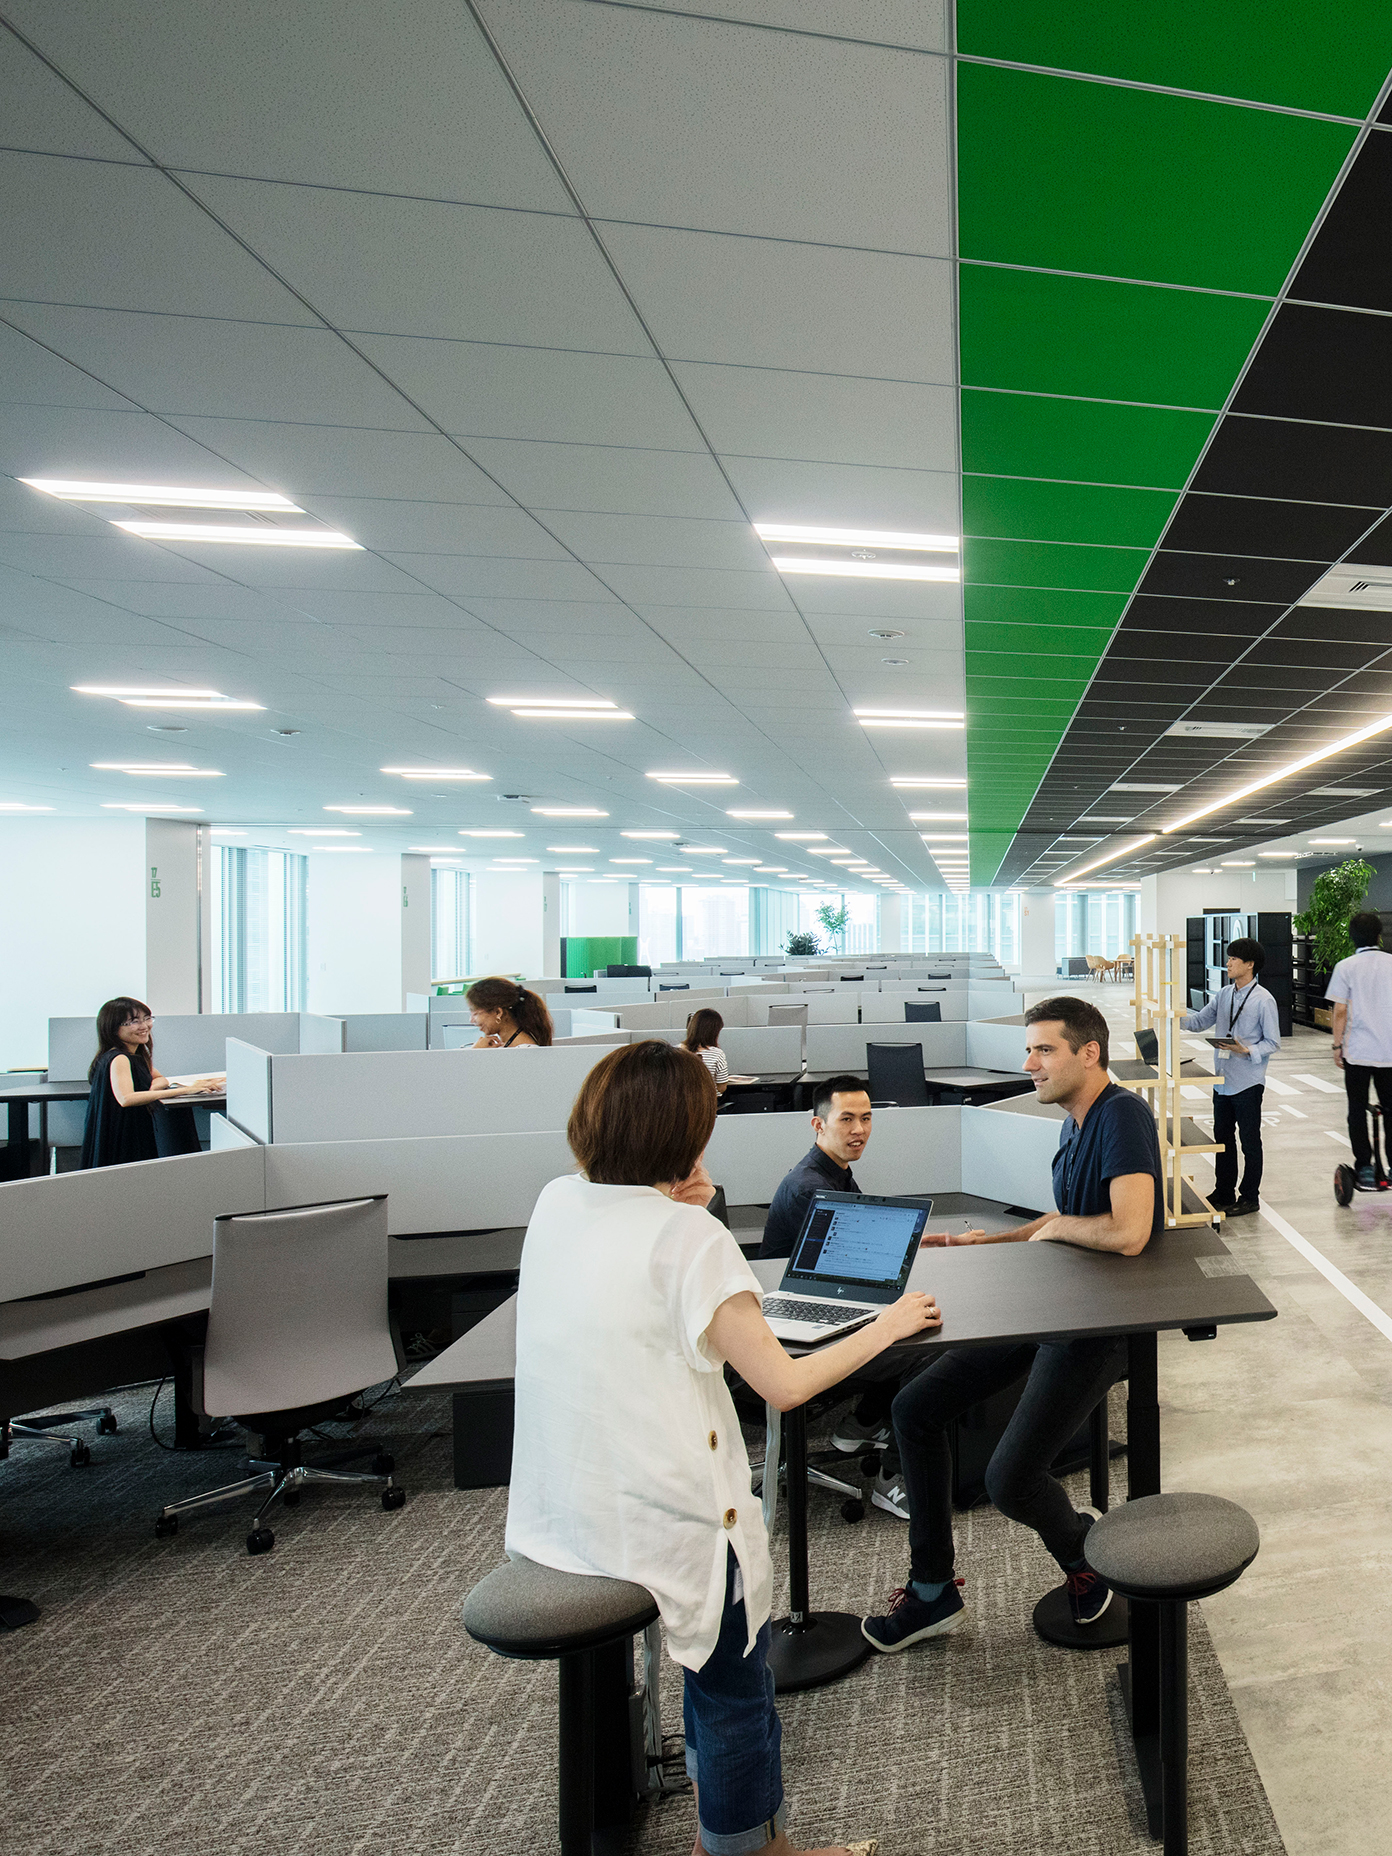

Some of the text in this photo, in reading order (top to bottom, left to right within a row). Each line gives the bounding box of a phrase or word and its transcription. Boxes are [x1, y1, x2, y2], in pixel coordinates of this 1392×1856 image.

[151, 867, 157, 878] 17
[151, 881, 161, 898] E5
[887, 1485, 906, 1504] N
